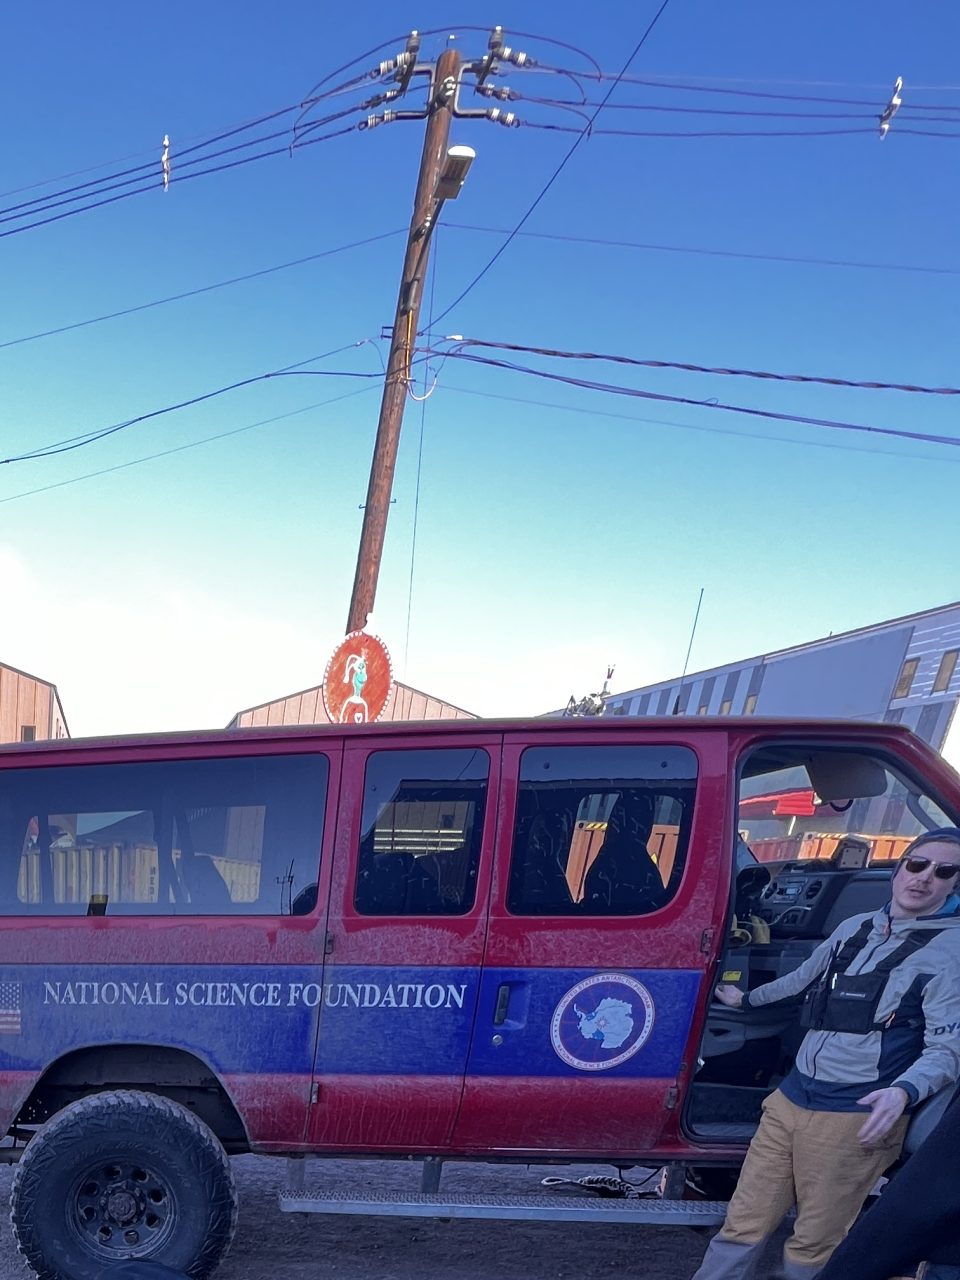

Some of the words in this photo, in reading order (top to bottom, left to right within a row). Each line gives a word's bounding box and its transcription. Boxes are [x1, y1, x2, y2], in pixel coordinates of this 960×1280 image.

[43, 981, 170, 1006] NATIONAL
[174, 982, 281, 1006] SCIENCE
[286, 983, 468, 1009] FOUNDATION
[561, 989, 578, 1008] UNITED
[578, 976, 600, 990] STATES
[601, 975, 633, 986] ANTARCTIC
[634, 984, 652, 1008] PROGRAM
[557, 1044, 576, 1066] NATIONAL
[576, 1061, 600, 1069] SCIENCE
[601, 1045, 637, 1068] FOUNDATION
